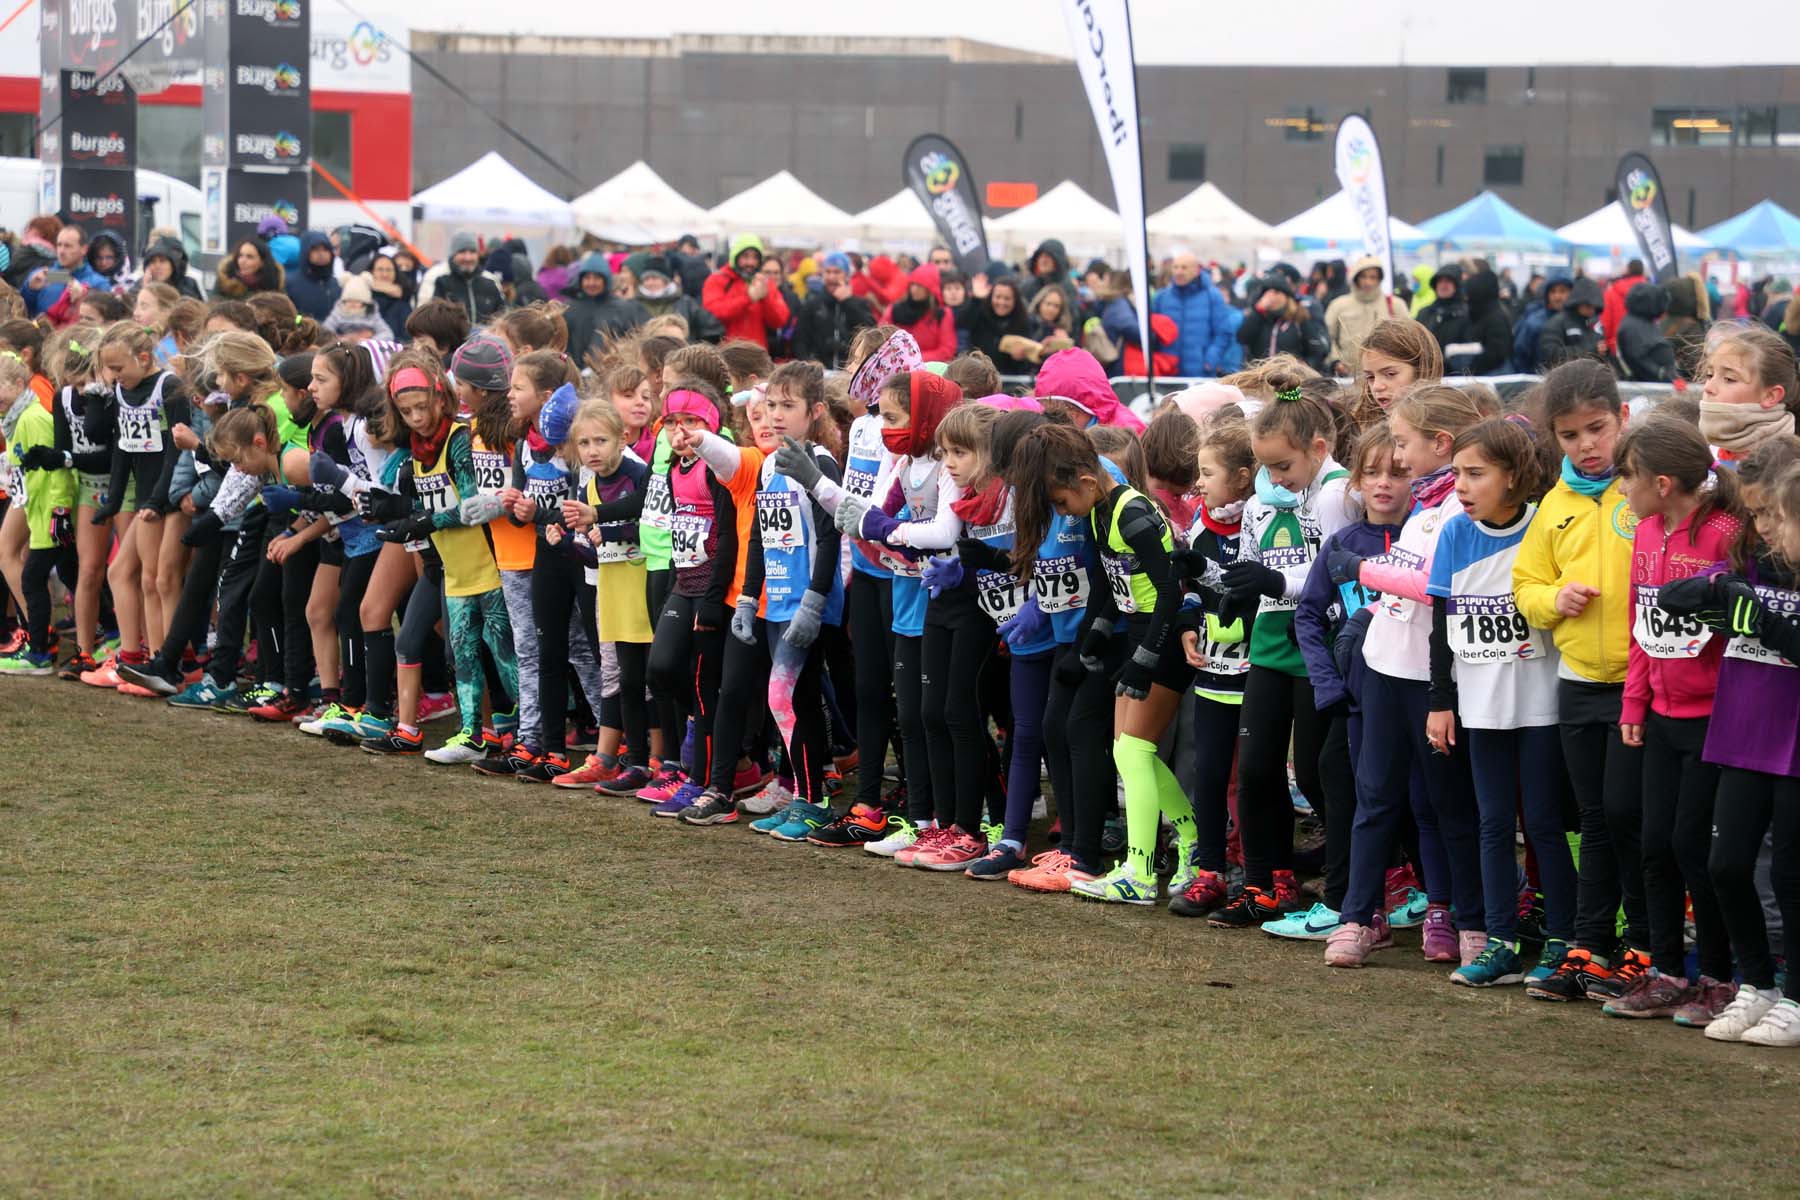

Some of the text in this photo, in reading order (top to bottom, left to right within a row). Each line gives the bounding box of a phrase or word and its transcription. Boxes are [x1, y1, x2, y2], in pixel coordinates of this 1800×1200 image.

[237, 62, 300, 92] Burgos
[71, 131, 125, 157] Burgos
[237, 131, 300, 159] Burgos
[70, 193, 124, 218] Burgos
[475, 467, 505, 488] 029
[644, 488, 672, 514] 050
[756, 492, 791, 500] UTACIÓN
[757, 499, 792, 507] RGOS
[672, 514, 707, 524] UTACIÓN
[760, 508, 792, 532] 949
[672, 530, 700, 552] 694
[1034, 555, 1075, 567] TACIÓN
[1034, 563, 1077, 574] RGOS
[1035, 572, 1079, 597] 079
[1108, 572, 1130, 598] 60
[1638, 586, 1659, 596] DIPUT
[1040, 600, 1059, 610] Caja
[1456, 595, 1515, 606] DIPUTACIÓ
[1639, 595, 1658, 606] BUR
[1456, 604, 1516, 614] BURGO
[1460, 612, 1530, 644] 1889
[1459, 648, 1507, 660] iberCaja
